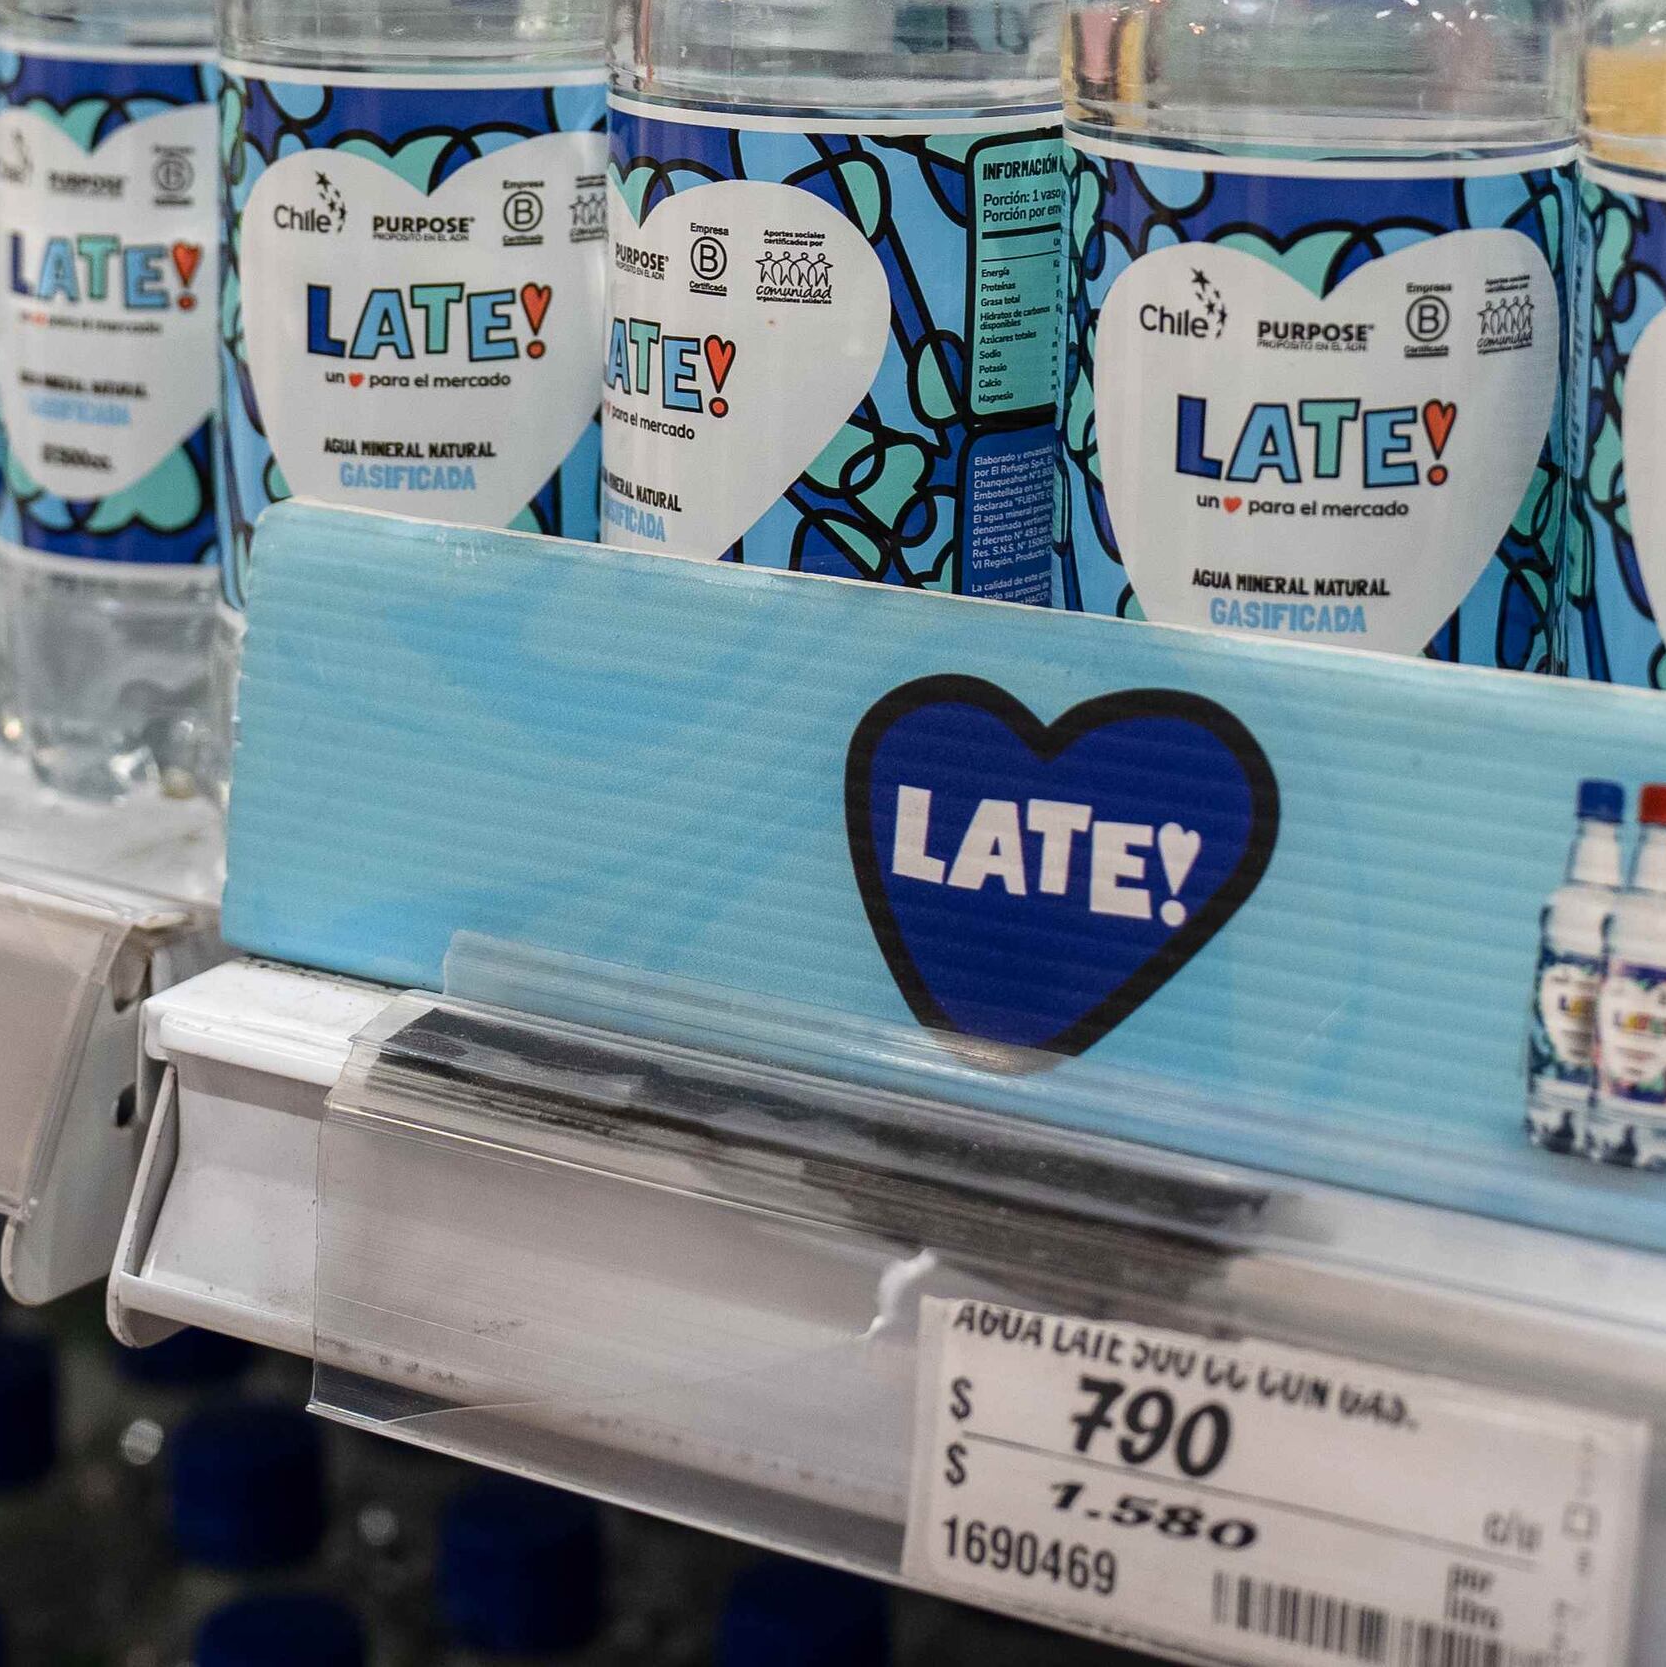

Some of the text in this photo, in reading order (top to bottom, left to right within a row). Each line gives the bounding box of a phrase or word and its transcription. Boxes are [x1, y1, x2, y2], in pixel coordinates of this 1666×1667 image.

[983, 153, 1058, 181] INFORMACIÓN
[983, 190, 1031, 207] Porción:
[1032, 189, 1039, 202] 1
[274, 205, 331, 233] Chile
[983, 206, 1046, 223] Porción por
[690, 222, 729, 236] Empresa
[763, 229, 826, 240] Aportes sociales
[763, 237, 823, 247] certificados por
[10, 231, 202, 312] LATE!
[981, 267, 1010, 278] Energía
[755, 284, 832, 300] comunidad
[981, 281, 1016, 292] Proteínas
[980, 294, 1020, 307] Grasa total
[306, 282, 552, 362] LATE!
[980, 310, 1012, 321] Hidratos
[1013, 308, 1023, 317] de
[1140, 303, 1209, 338] Chile
[980, 319, 1021, 331] disponibles
[979, 330, 1037, 345] Azúcares totales
[979, 348, 1001, 359] Sodio
[603, 318, 736, 418] ATE!
[979, 363, 1007, 374] Potasio
[325, 371, 511, 388] un para el mercado
[978, 377, 1002, 388] Calcio
[978, 390, 1014, 403] Magnesio
[612, 404, 695, 440] para el mercado
[324, 438, 497, 459] AGUA MINERAL NATURAL
[1175, 394, 1457, 489] LATE!
[974, 453, 1016, 466] Elaborado
[339, 462, 477, 491] GASIFICADA
[974, 469, 989, 479] por
[636, 484, 682, 512] NATURAL
[973, 499, 1013, 512] declarada
[1196, 494, 1409, 517] un para el mercado
[983, 513, 1004, 524] agua
[1192, 568, 1390, 596] AGUA MINERAL NATURAL
[1210, 597, 1367, 632] GASIFICADA
[892, 784, 1202, 927] LATE!
[949, 1375, 1231, 1479] $ 790
[944, 1443, 1259, 1552] $ 1.580
[940, 1516, 1118, 1598] 1690469
